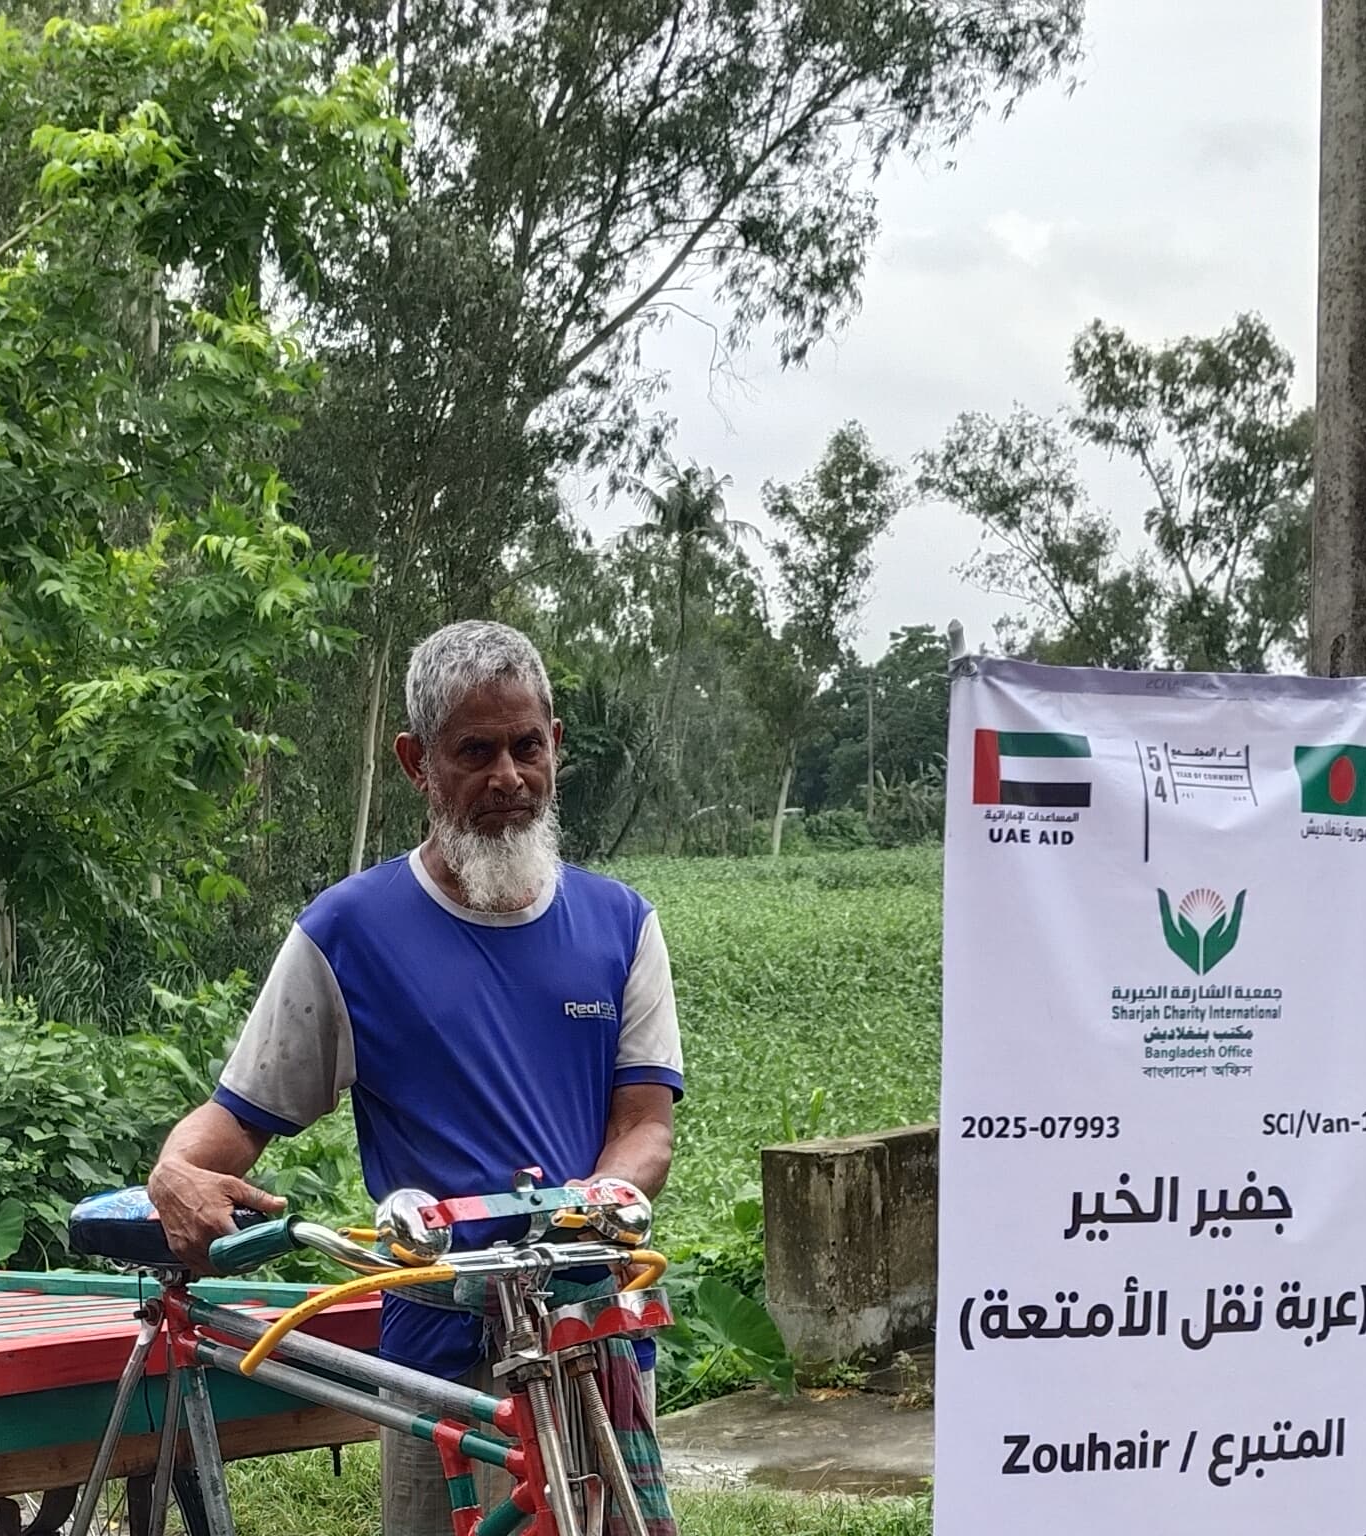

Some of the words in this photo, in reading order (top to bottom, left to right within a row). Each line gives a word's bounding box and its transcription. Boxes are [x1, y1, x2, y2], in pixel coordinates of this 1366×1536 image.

[988, 827, 1031, 844] UAE
[1038, 830, 1075, 846] AID
[1111, 985, 1168, 1005] الخيرية
[1170, 983, 1232, 1004] الشارقة
[1234, 985, 1283, 1000] جمعية
[1111, 1004, 1161, 1024] Sharjah
[1163, 1004, 1207, 1023] Charity
[1208, 1004, 1282, 1020] International
[1143, 1026, 1210, 1044] بنغلاديش
[1212, 1024, 1254, 1043] مكتب
[1144, 1045, 1216, 1062] Bangladesh
[1217, 1044, 1253, 1058] Office
[1141, 1065, 1208, 1079] বাংলাদেশ
[1210, 1061, 1253, 1077] অফিস
[961, 1115, 1120, 1139] 2025-07993
[1063, 1172, 1180, 1242] الخير
[1189, 1170, 1293, 1239] جفير
[959, 1275, 1168, 1351] الأمتعة)
[1181, 1283, 1264, 1351] نقل
[1001, 1429, 1170, 1475] Zouhair
[1179, 1430, 1198, 1473] /
[1207, 1417, 1346, 1488] المتبرع
